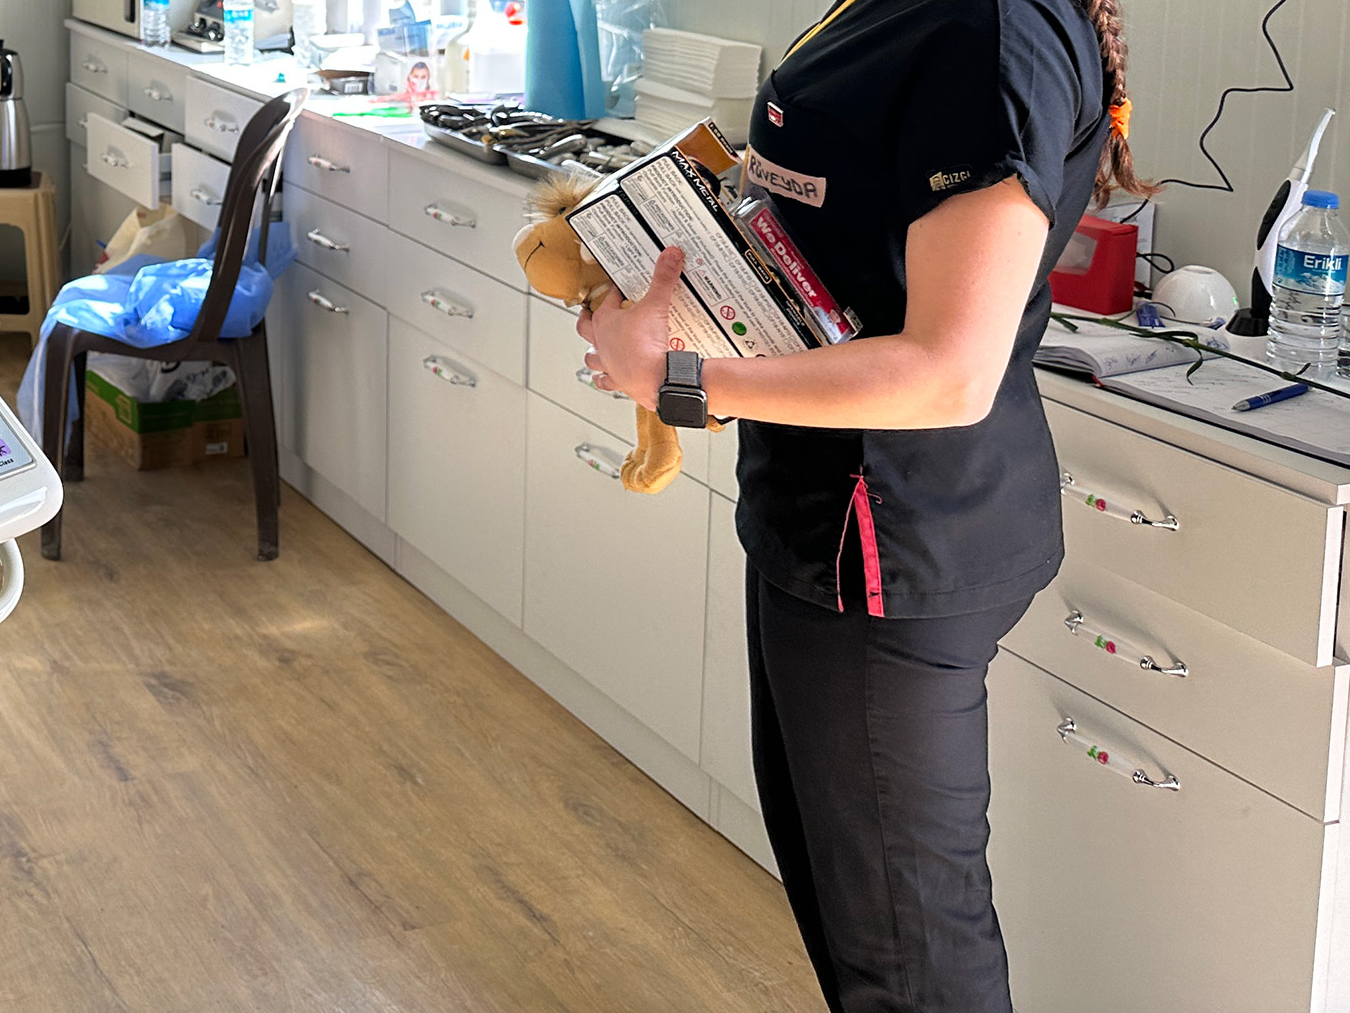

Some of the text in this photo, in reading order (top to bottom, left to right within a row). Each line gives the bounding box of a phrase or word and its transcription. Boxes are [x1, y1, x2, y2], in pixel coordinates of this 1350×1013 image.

[754, 216, 778, 244] We
[772, 240, 819, 299] Deliver
[1304, 255, 1342, 270] Erikli
